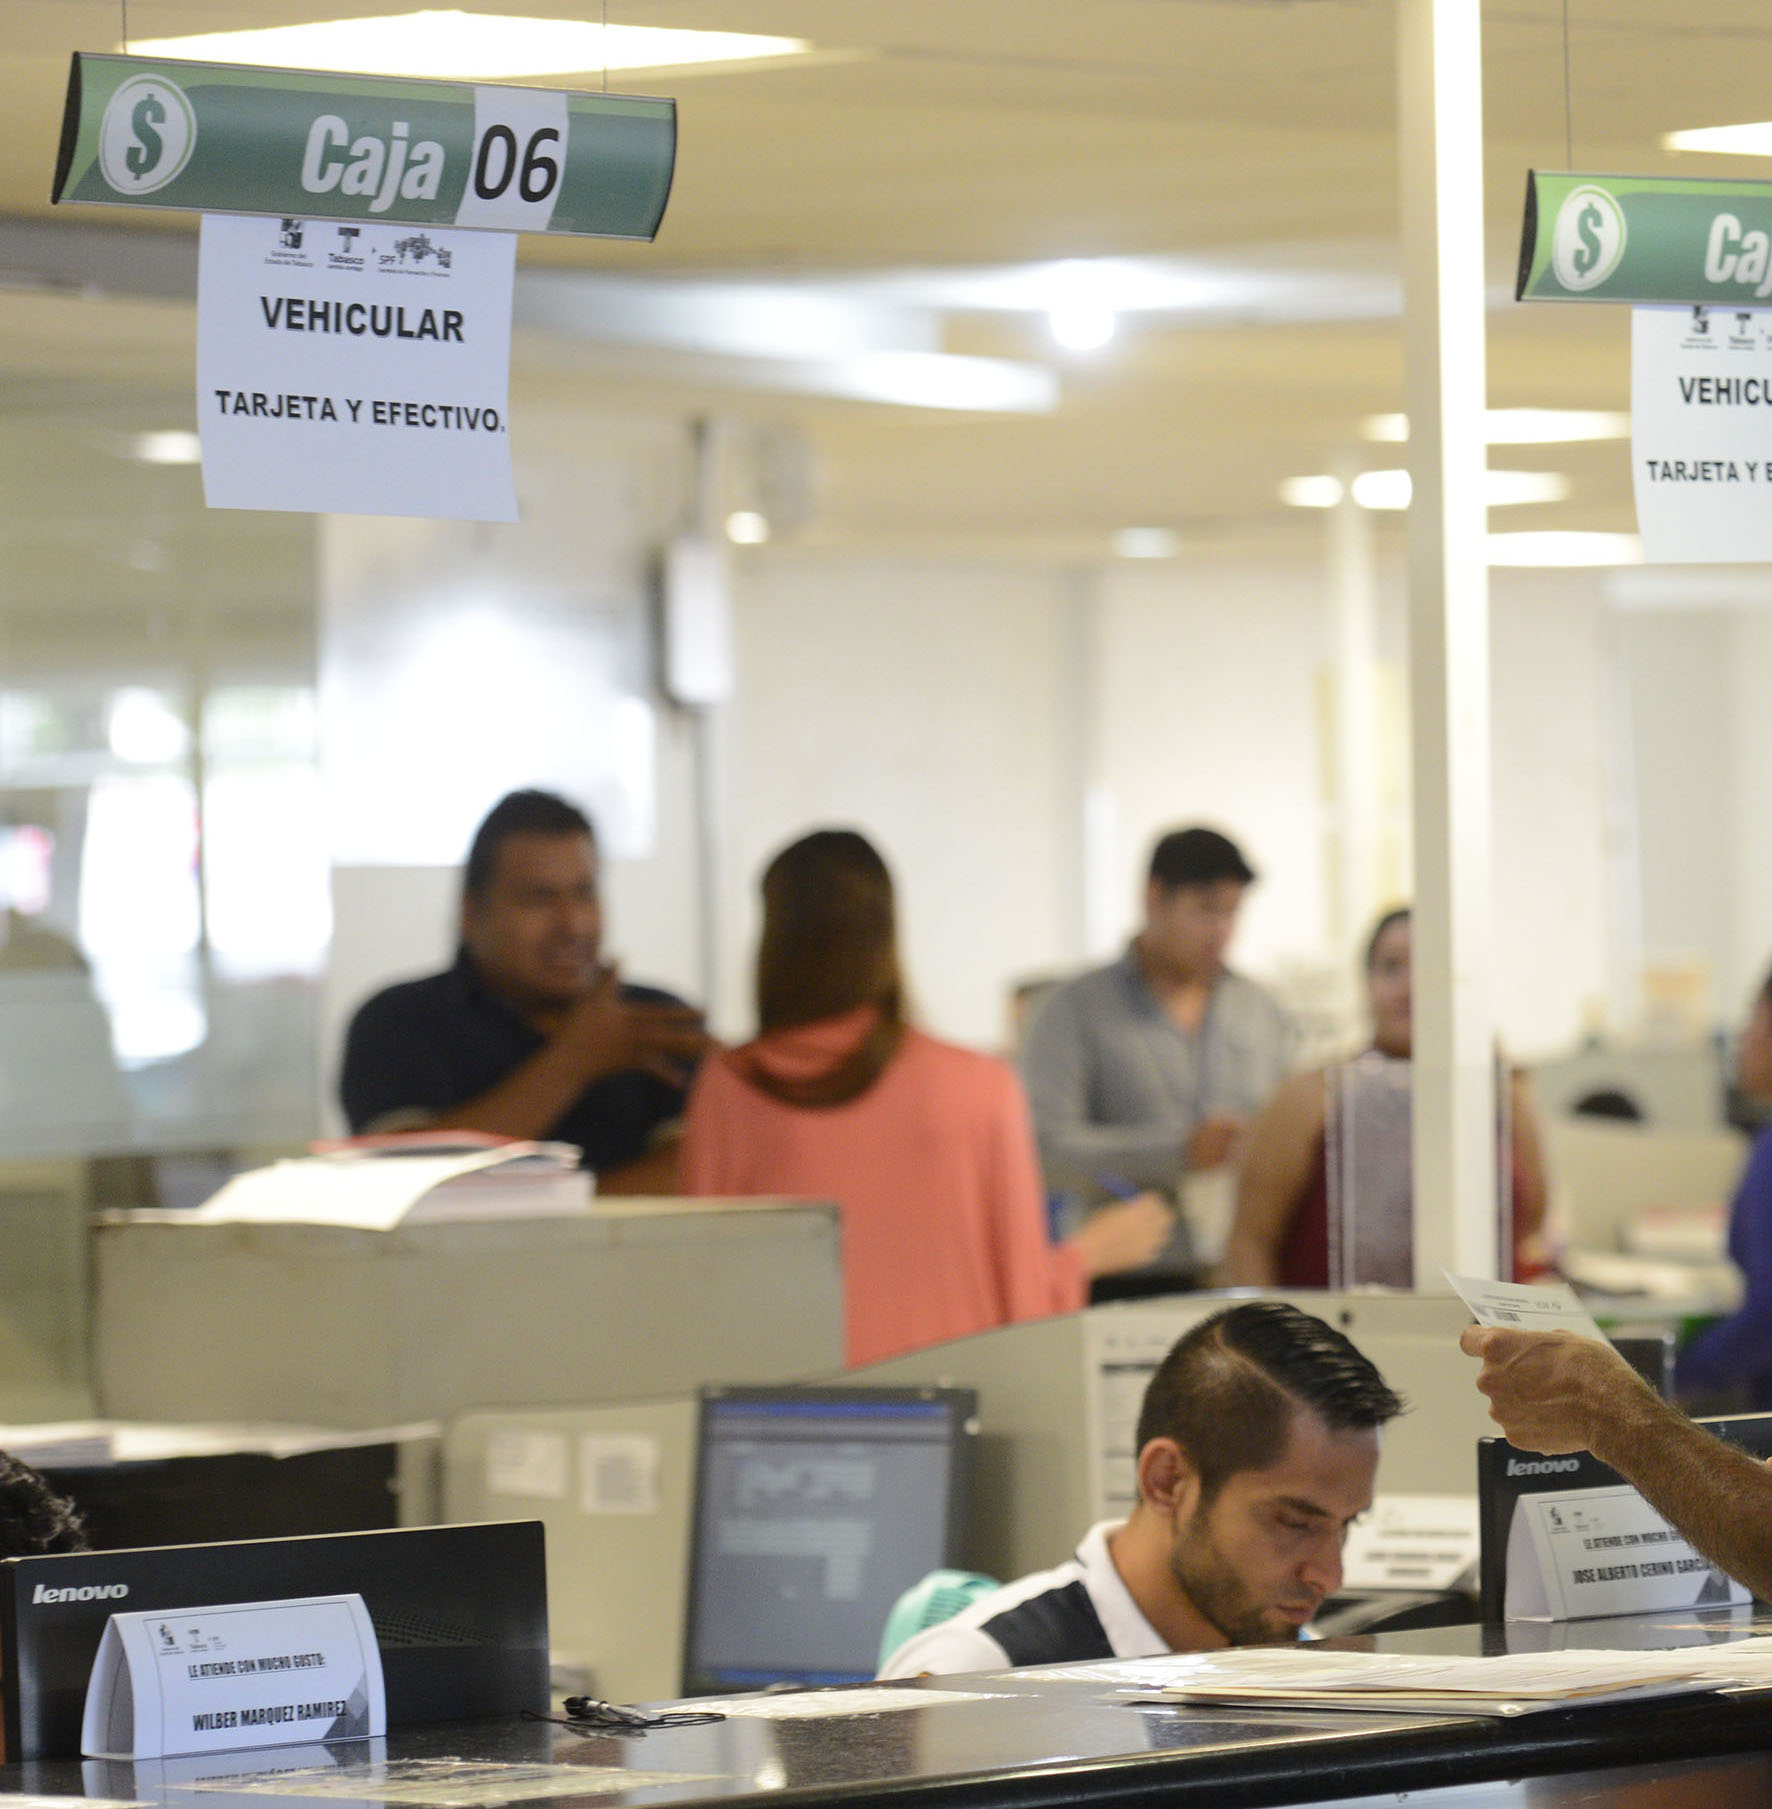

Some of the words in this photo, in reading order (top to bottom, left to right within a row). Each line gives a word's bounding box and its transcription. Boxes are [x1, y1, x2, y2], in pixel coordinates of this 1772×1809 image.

[301, 114, 447, 213] Caja
[473, 124, 560, 203] 06
[260, 295, 465, 344] VEHICULAR
[215, 389, 338, 422] TARJETA
[345, 398, 363, 423] Y
[372, 400, 506, 433] EFECTIVO.
[1646, 460, 1740, 482] TARJETA
[1746, 461, 1759, 482] Y
[1506, 1458, 1580, 1477] lenovo
[1572, 1568, 1597, 1585] JOSE
[1597, 1564, 1638, 1582] ALBERTO
[32, 1583, 130, 1605] lenovo
[188, 1664, 199, 1679] LE
[192, 1711, 238, 1732] WILBER
[240, 1704, 295, 1727] MARQUEZ
[297, 1699, 347, 1721] RAMIREZ
